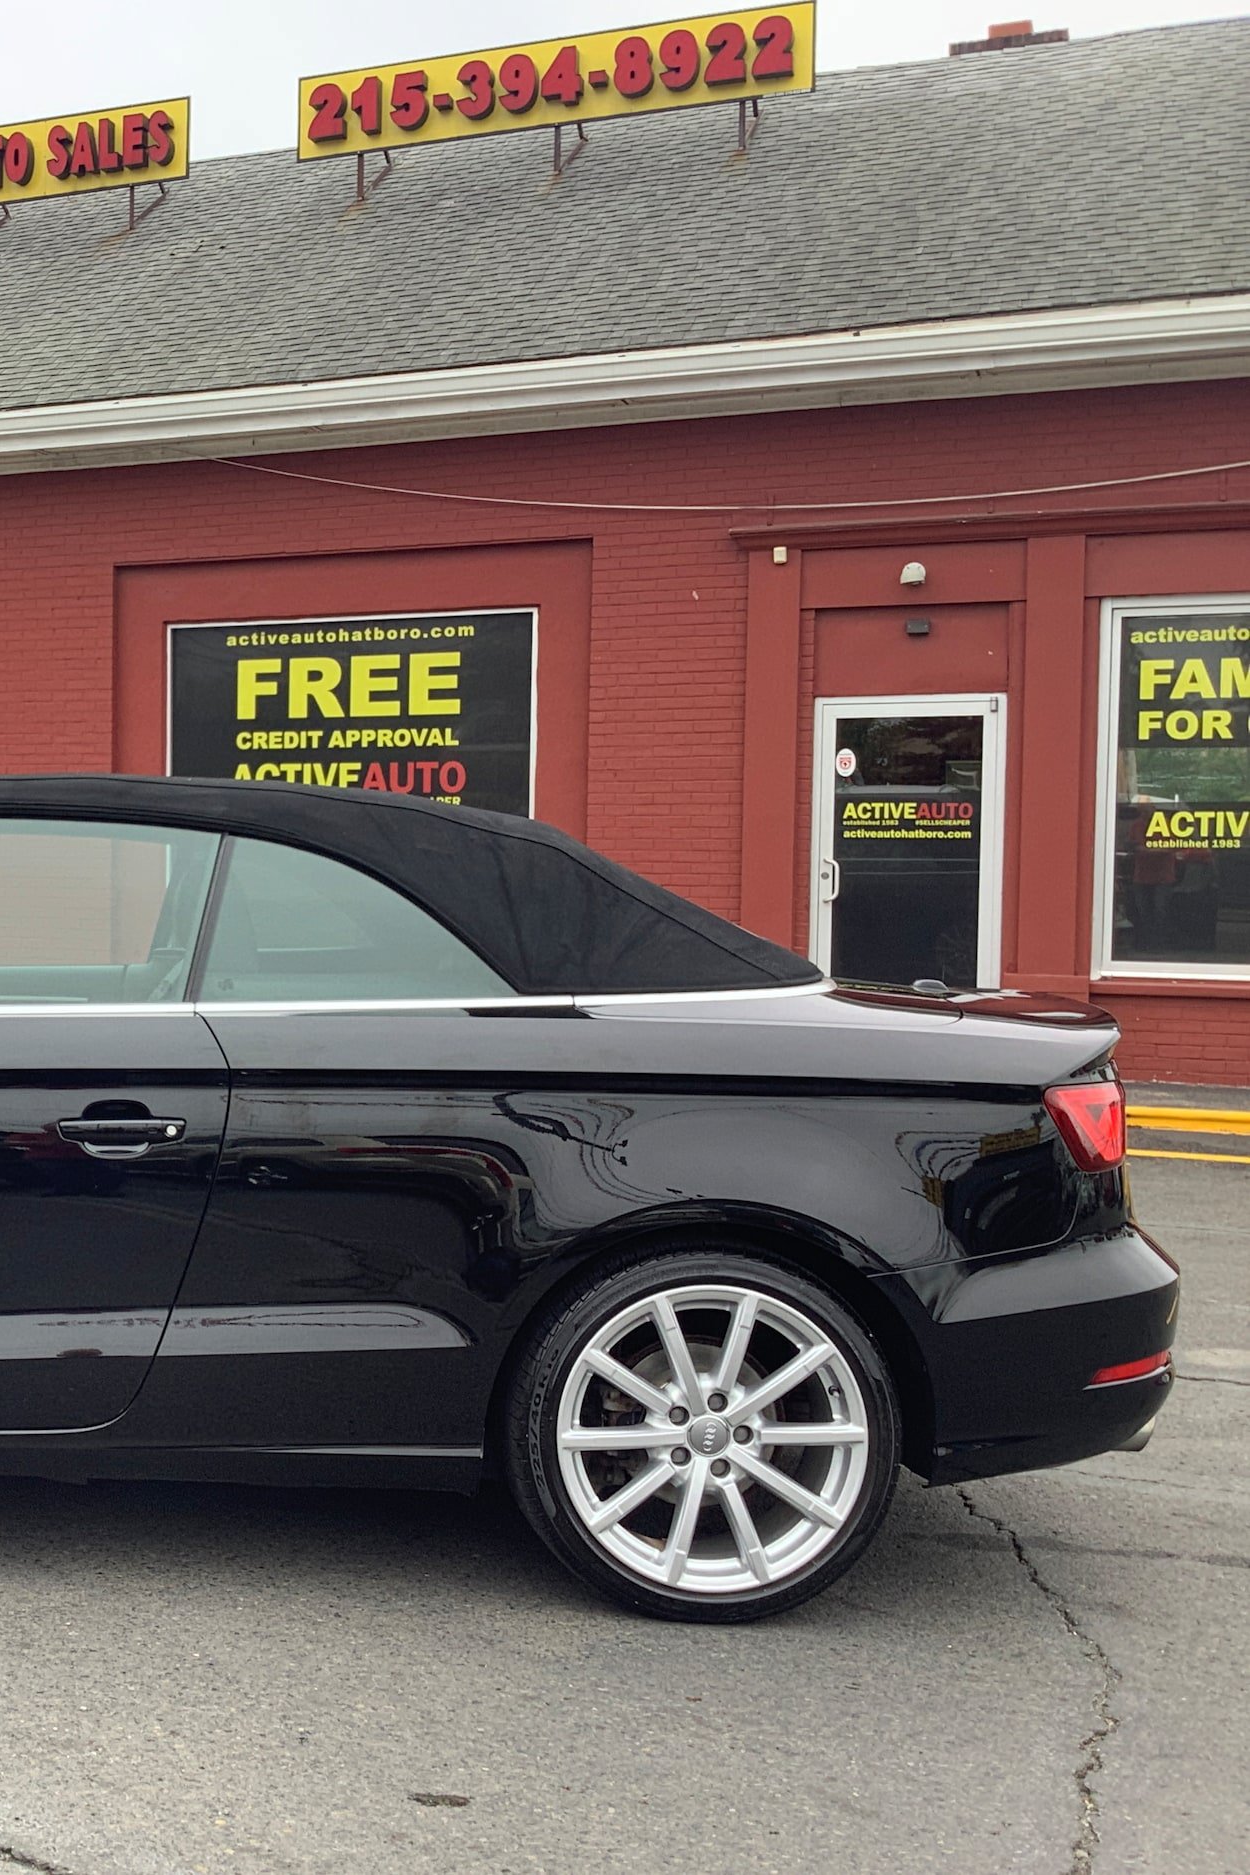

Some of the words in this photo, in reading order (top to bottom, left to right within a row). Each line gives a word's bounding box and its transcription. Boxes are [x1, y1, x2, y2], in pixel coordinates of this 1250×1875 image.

[307, 14, 796, 144] 215-394-8922
[47, 110, 174, 179] SALES
[226, 624, 475, 647] activeautohatboro.com
[236, 651, 461, 720] FREE
[1138, 709, 1233, 741] FOR
[236, 730, 323, 750] CREDIT
[328, 728, 459, 749] APPROVAL
[843, 828, 972, 839] activeautohatboro.com
[1146, 839, 1208, 849] established
[1211, 838, 1241, 849] 1983
